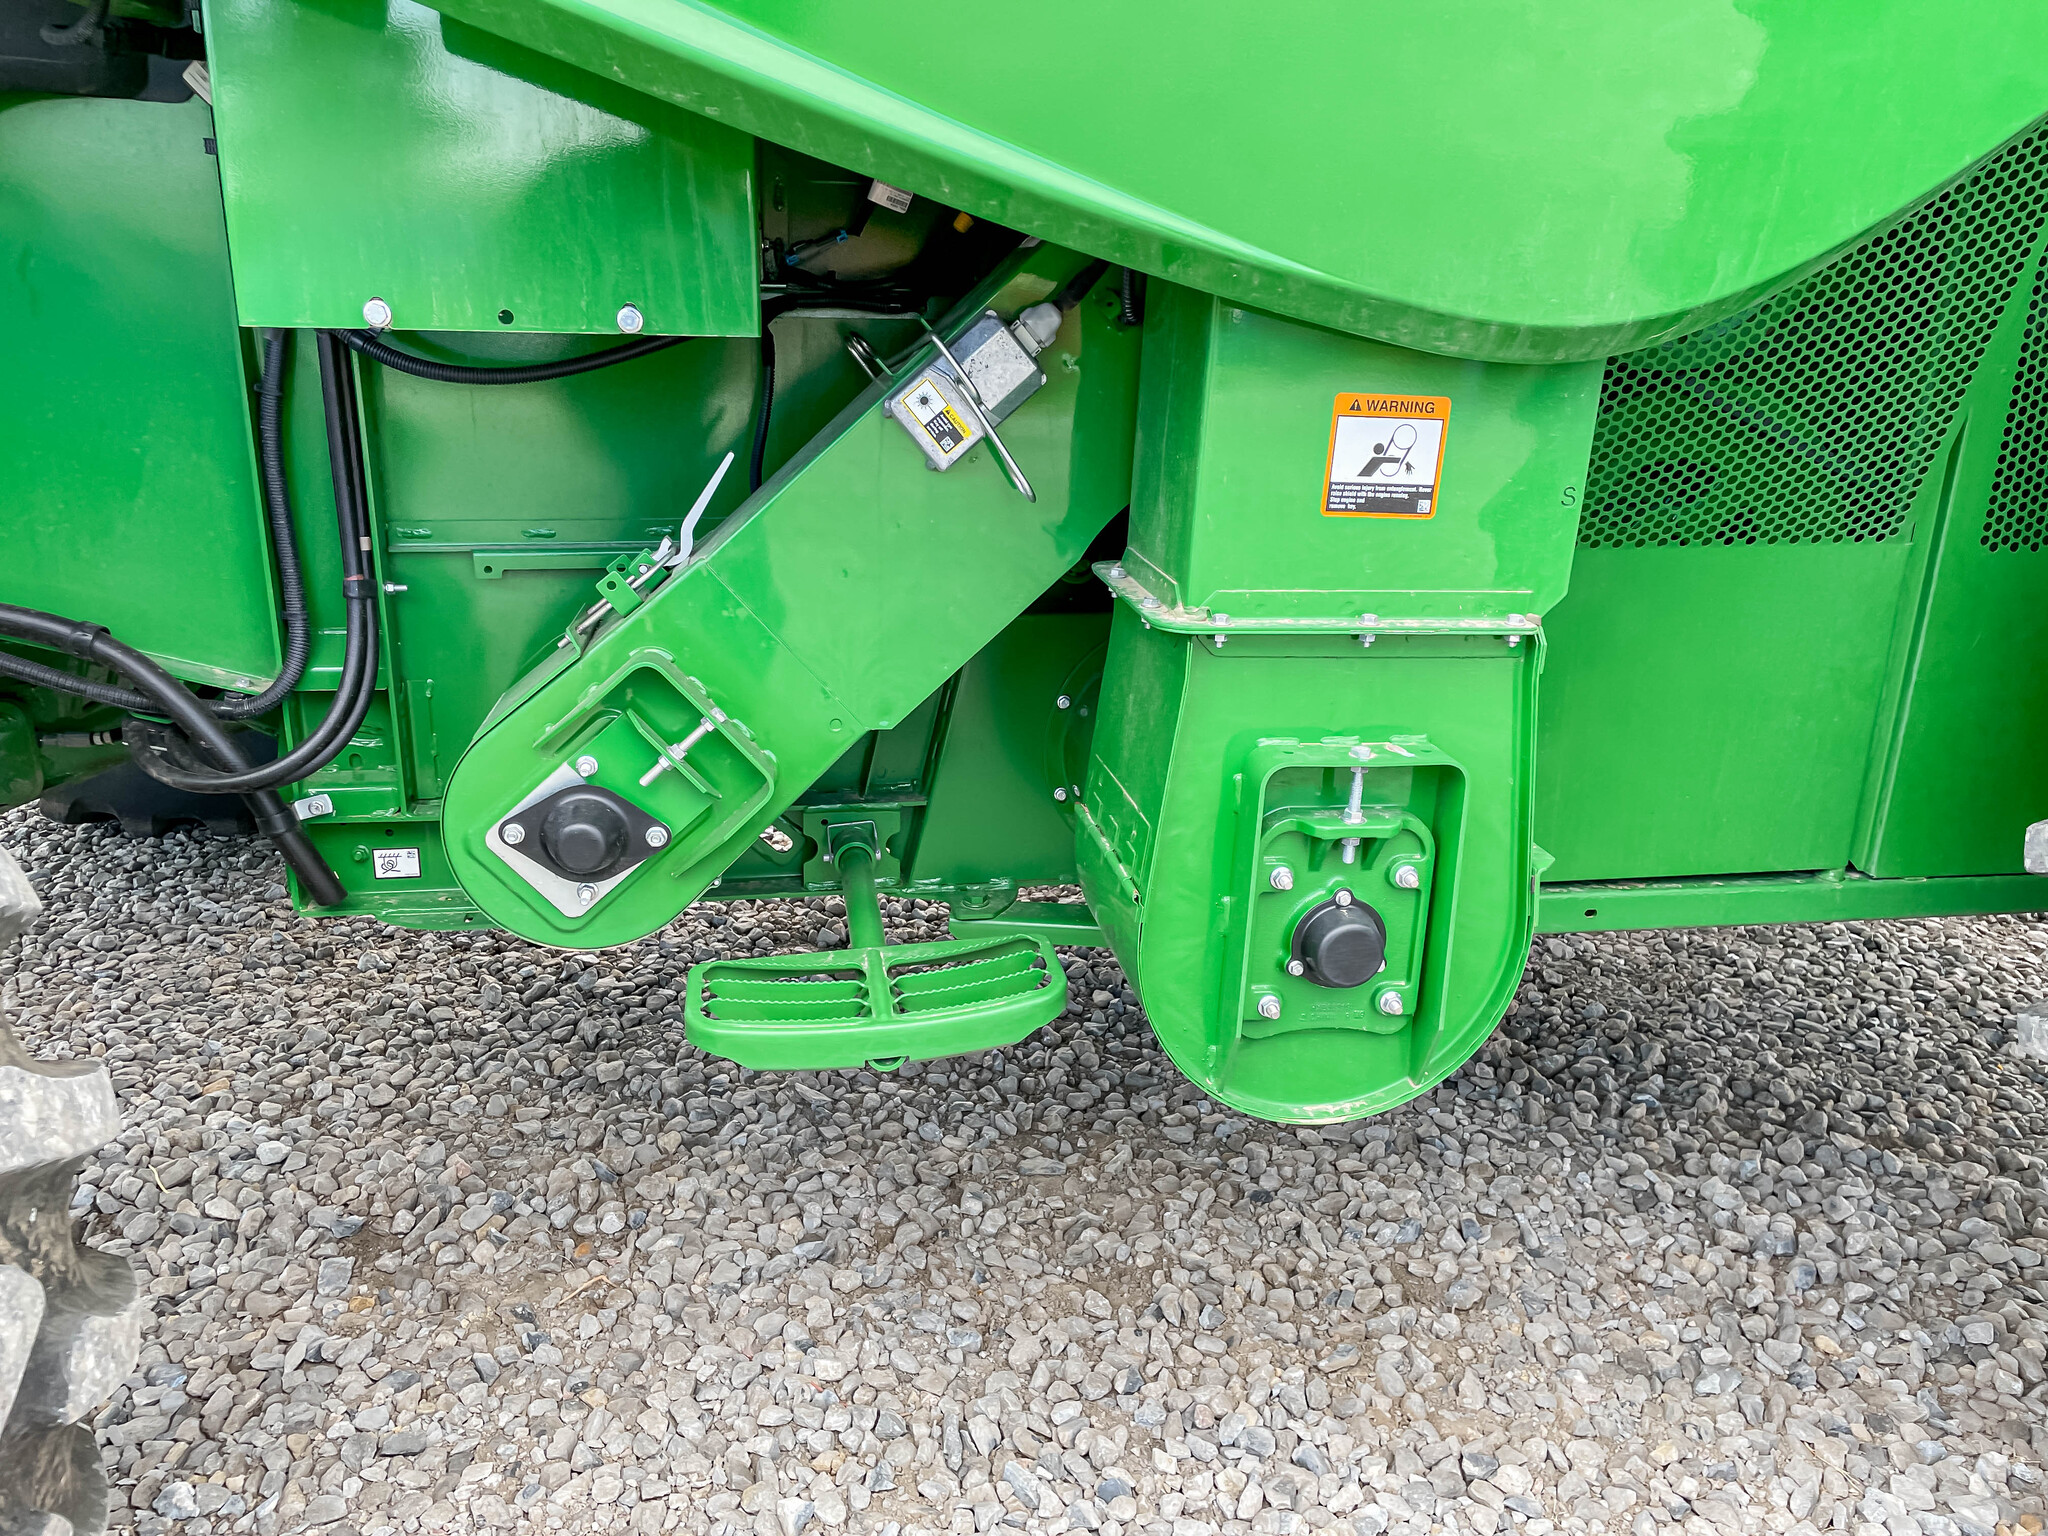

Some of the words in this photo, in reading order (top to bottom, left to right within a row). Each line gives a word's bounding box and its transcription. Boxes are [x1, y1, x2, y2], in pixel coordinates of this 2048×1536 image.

[1366, 399, 1435, 414] WARNING
[949, 414, 967, 434] CAUTION
[1361, 484, 1375, 492] injury
[1386, 485, 1418, 493] entanglement.
[1390, 492, 1410, 500] running.
[1560, 486, 1577, 507] S
[1347, 503, 1357, 511] key.
